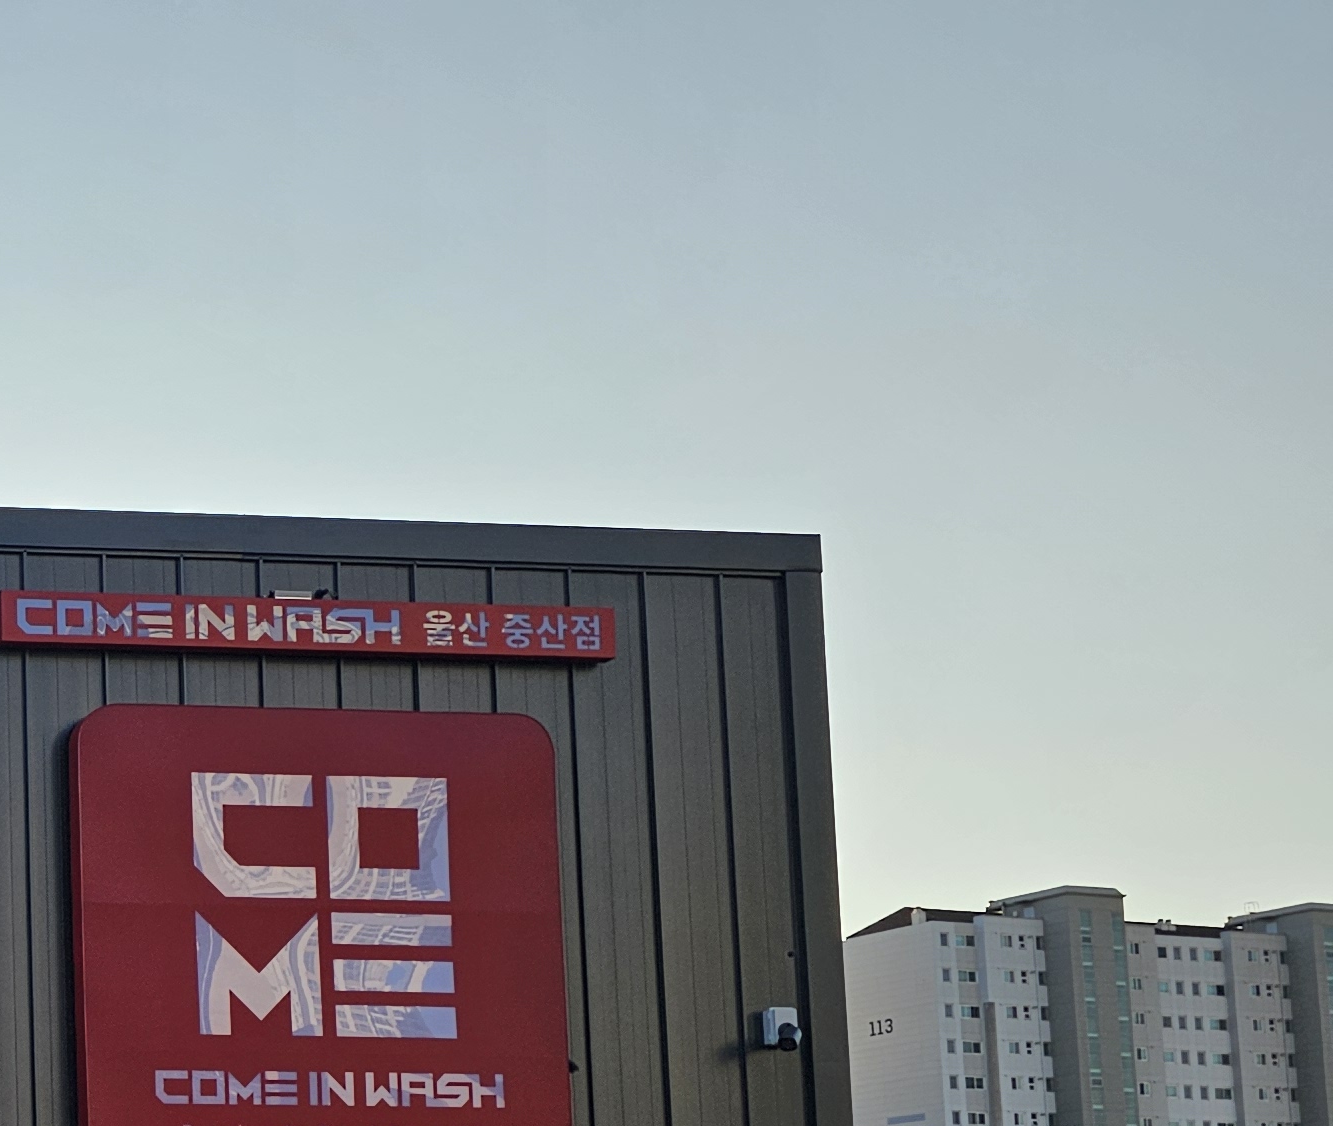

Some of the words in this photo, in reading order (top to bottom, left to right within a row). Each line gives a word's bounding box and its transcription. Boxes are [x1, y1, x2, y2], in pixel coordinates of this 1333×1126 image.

[17, 598, 173, 637] COME
[185, 603, 239, 640] IN
[247, 604, 402, 646] WASH
[423, 608, 490, 648] 울산
[502, 612, 602, 651] 중산점
[868, 1018, 894, 1037] 113
[154, 1069, 298, 1106] COME
[308, 1071, 355, 1107] IN
[365, 1072, 506, 1109] WASH
